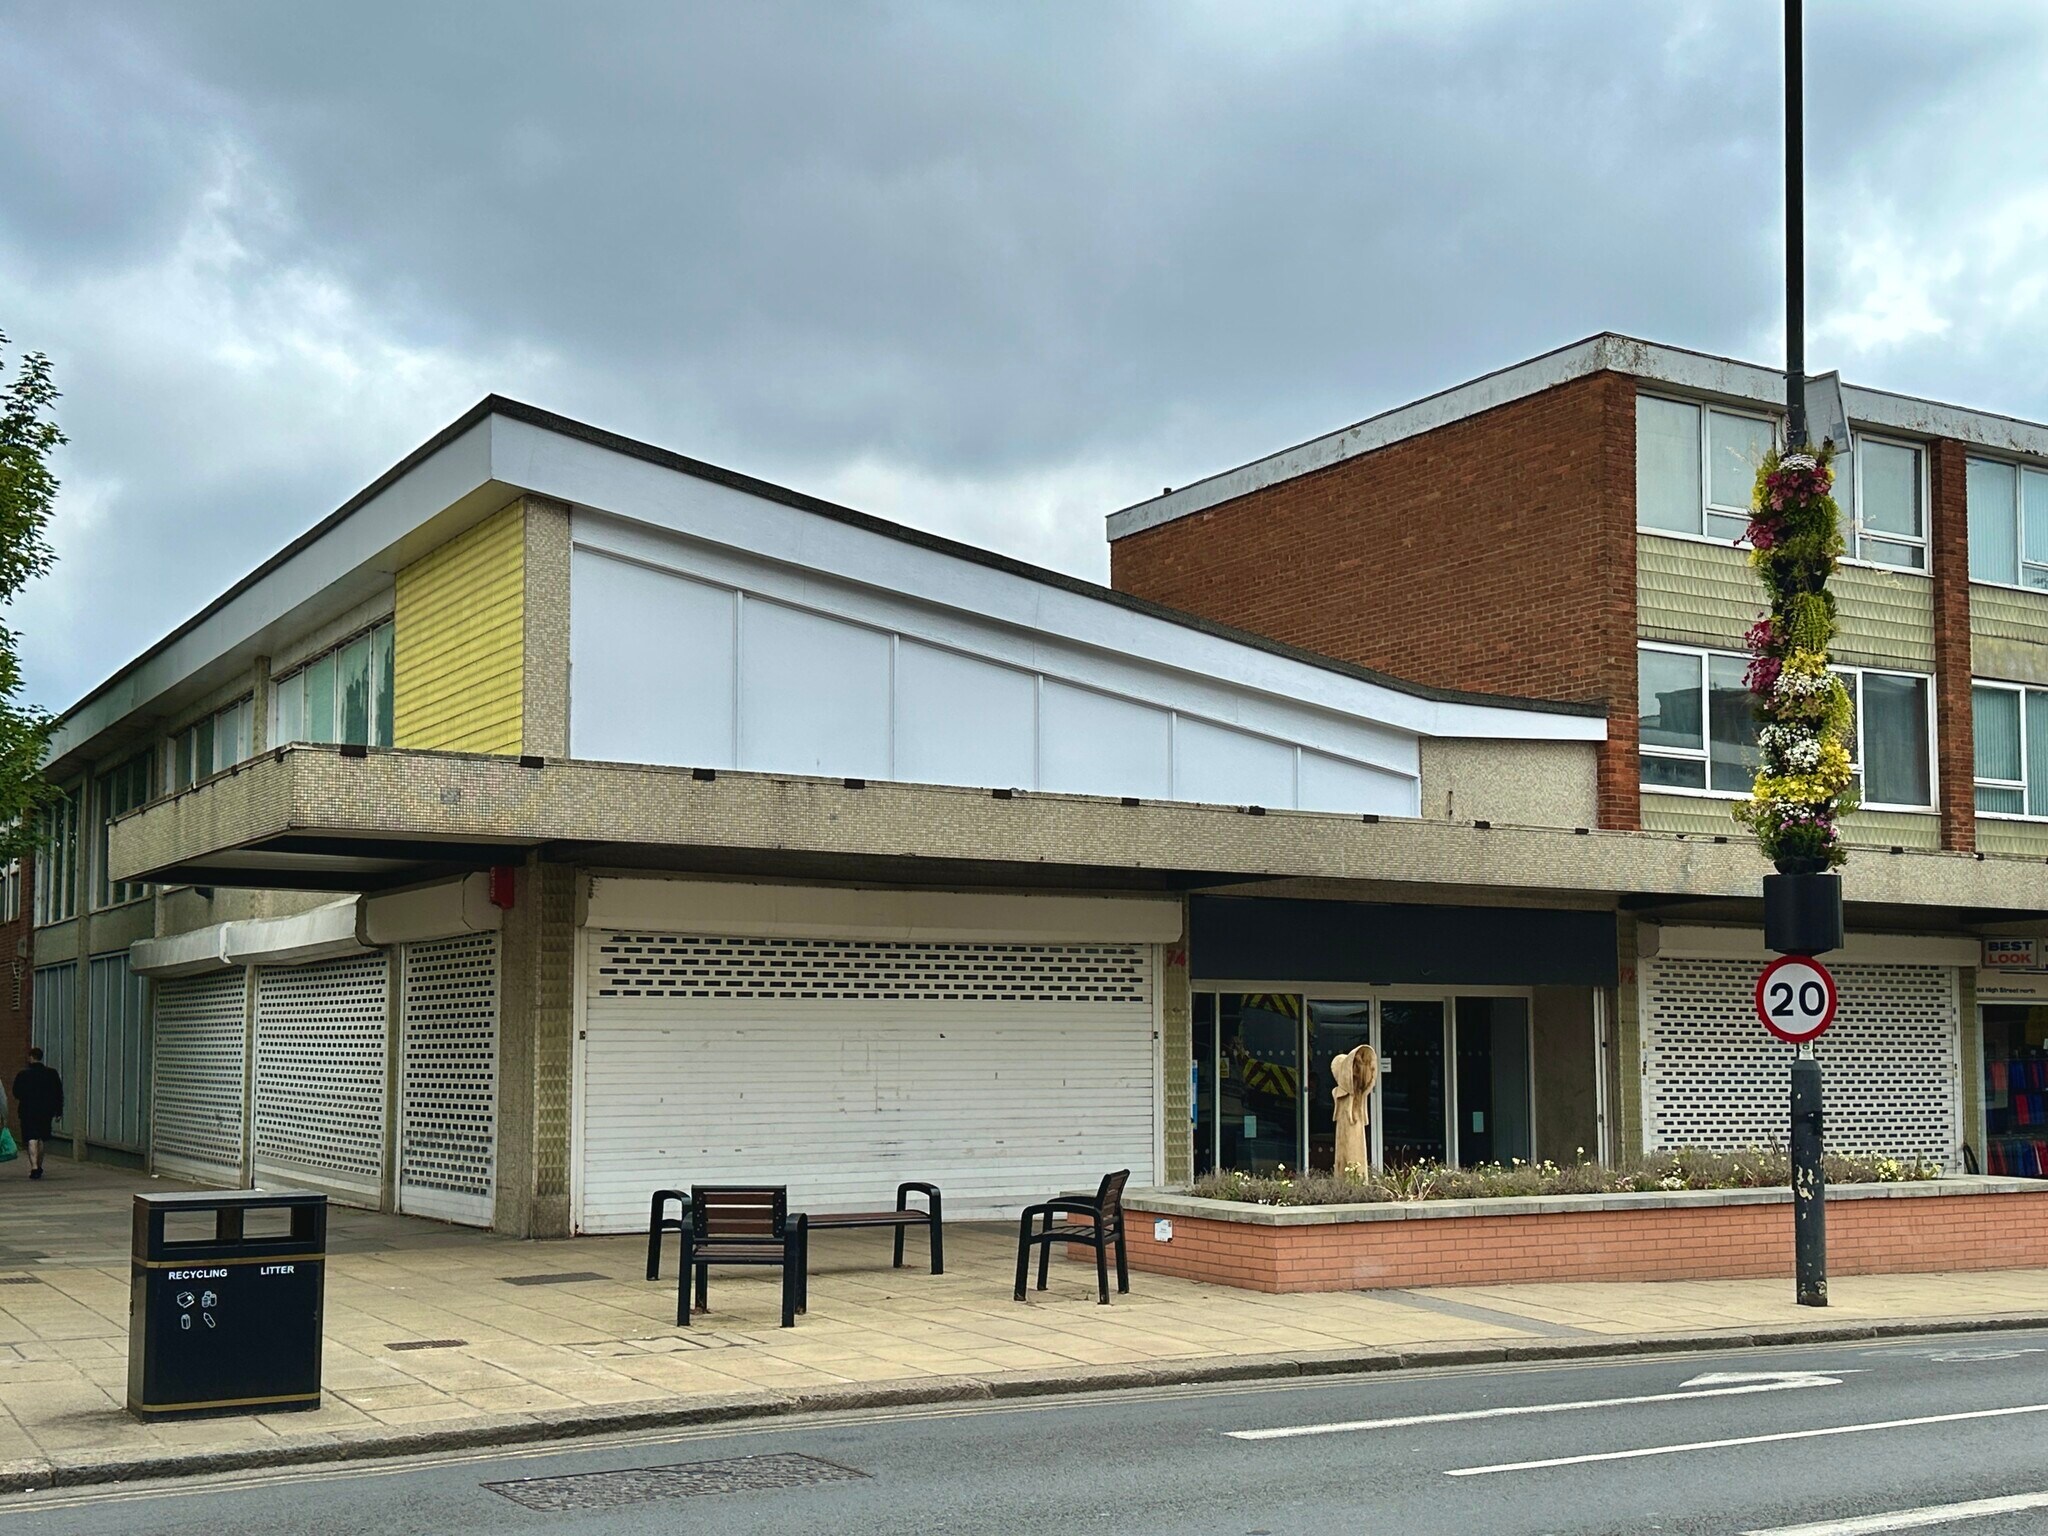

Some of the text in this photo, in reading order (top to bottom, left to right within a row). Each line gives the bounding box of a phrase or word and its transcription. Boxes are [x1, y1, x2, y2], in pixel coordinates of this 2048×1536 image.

[1988, 941, 2033, 952] BEST
[1989, 954, 2031, 963] LOOK
[1770, 981, 1826, 1017] 20
[168, 1268, 228, 1280] RECYCLING
[260, 1265, 295, 1276] LITTER
